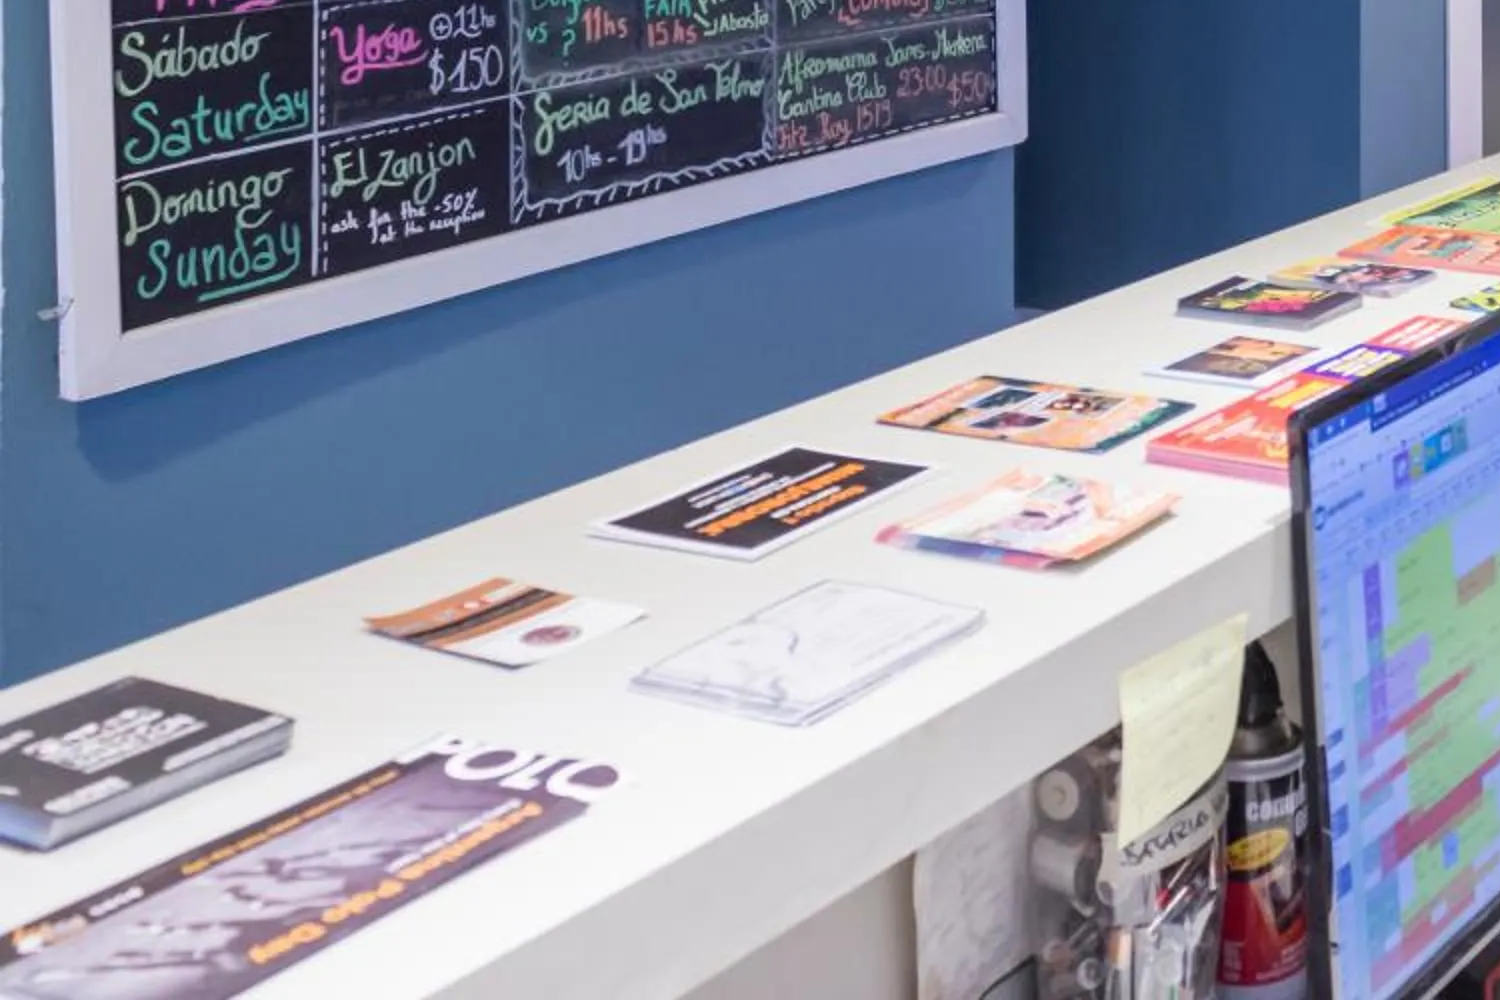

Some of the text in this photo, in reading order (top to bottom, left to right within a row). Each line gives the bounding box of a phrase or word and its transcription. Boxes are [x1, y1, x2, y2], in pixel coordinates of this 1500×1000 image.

[115, 18, 272, 98] Sábado
[329, 23, 429, 86] Yoga
[527, 23, 549, 43] vs
[620, 77, 653, 117] de
[655, 67, 708, 114] San
[704, 58, 766, 103] Telmo
[844, 70, 887, 102] Club
[123, 72, 310, 166] Saturday
[816, 110, 853, 145] Roy
[330, 136, 477, 206] El Zanjon
[121, 168, 294, 247] Domingo
[331, 210, 360, 234] ask
[400, 200, 427, 221] the
[379, 224, 397, 244] at
[405, 212, 424, 238] the
[137, 221, 300, 302] Sunday
